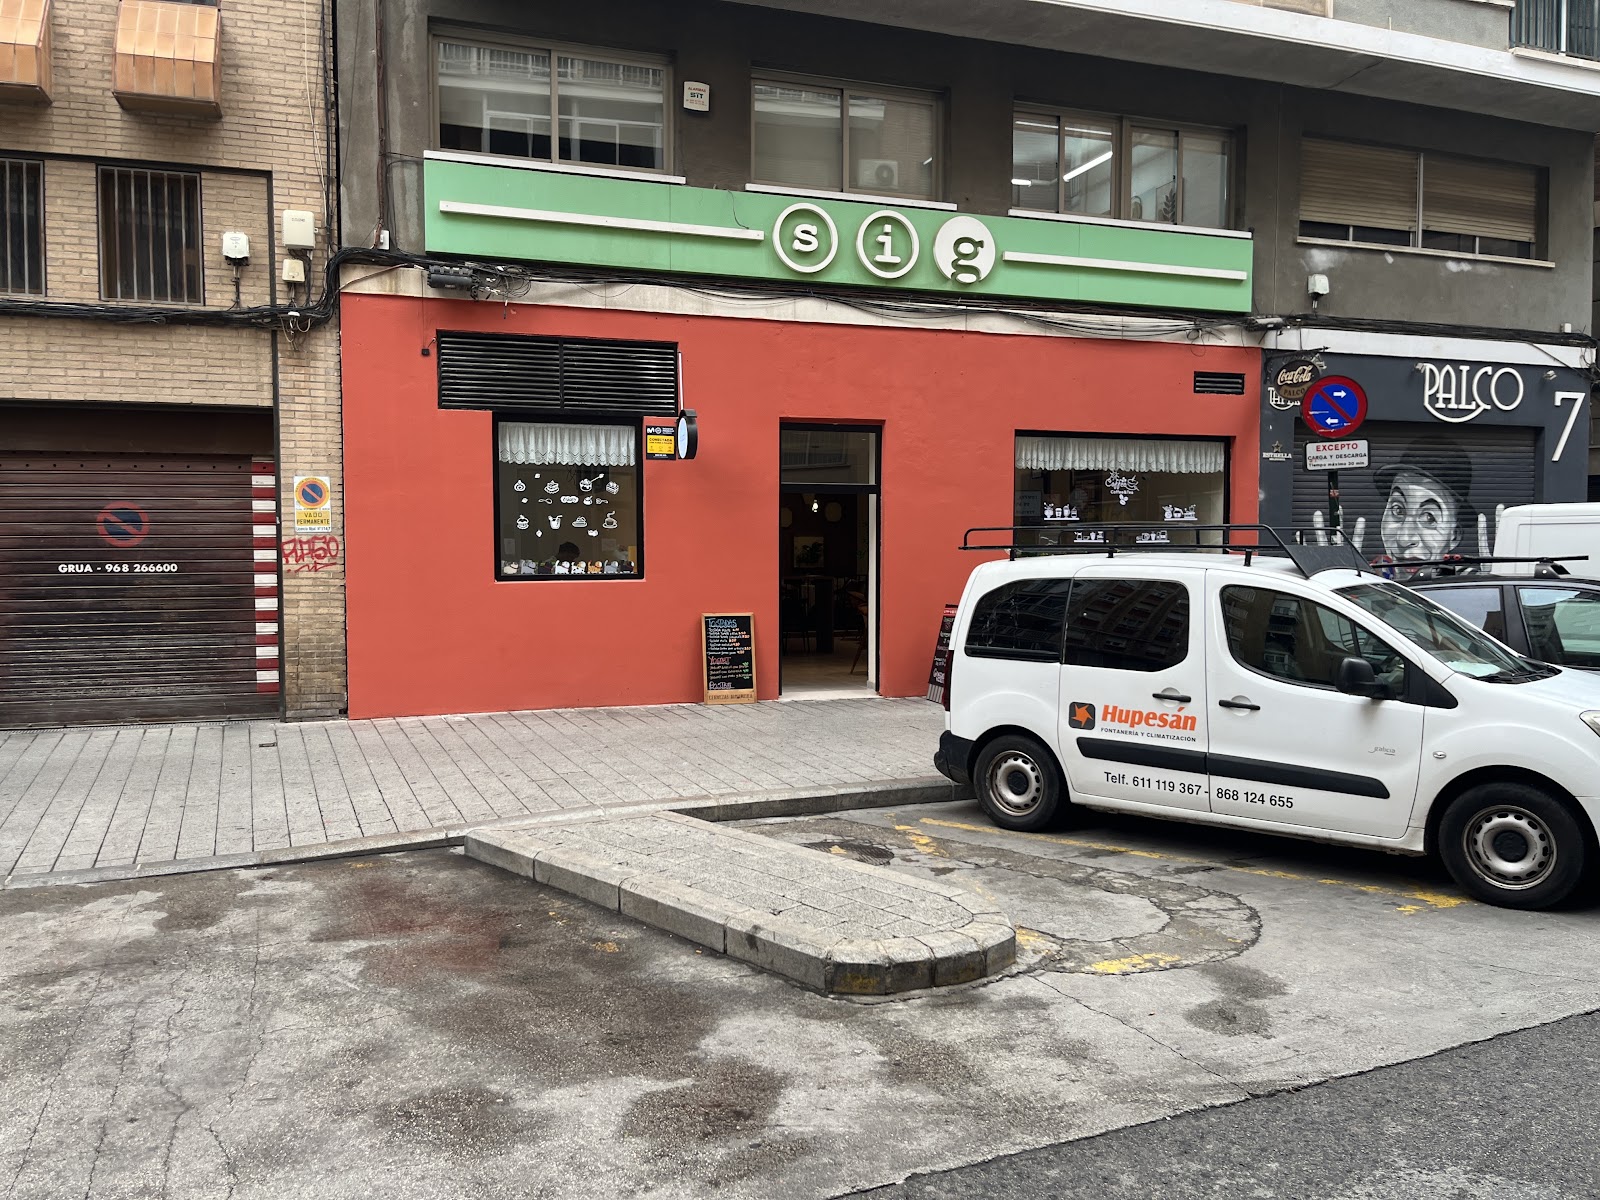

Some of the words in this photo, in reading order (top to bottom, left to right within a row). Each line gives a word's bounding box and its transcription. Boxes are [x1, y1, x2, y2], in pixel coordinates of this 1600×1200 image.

[1424, 363, 1524, 423] PALCO
[1552, 391, 1586, 462] 7
[1316, 443, 1358, 451] EXCEPTO
[58, 564, 93, 573] GRUA
[105, 563, 129, 572] 968
[133, 563, 178, 572] 266600
[1101, 704, 1197, 731] Hupesán
[1100, 727, 1139, 737] FONTANERÍA
[1146, 732, 1196, 742] CLIMATIZACIÓN
[1104, 771, 1129, 785] Telf.
[1132, 776, 1151, 789] 611
[1155, 779, 1175, 792] 119
[1179, 782, 1202, 796] 367
[1216, 787, 1239, 801] 868
[1243, 791, 1266, 805] 124
[1269, 794, 1294, 809] 655
